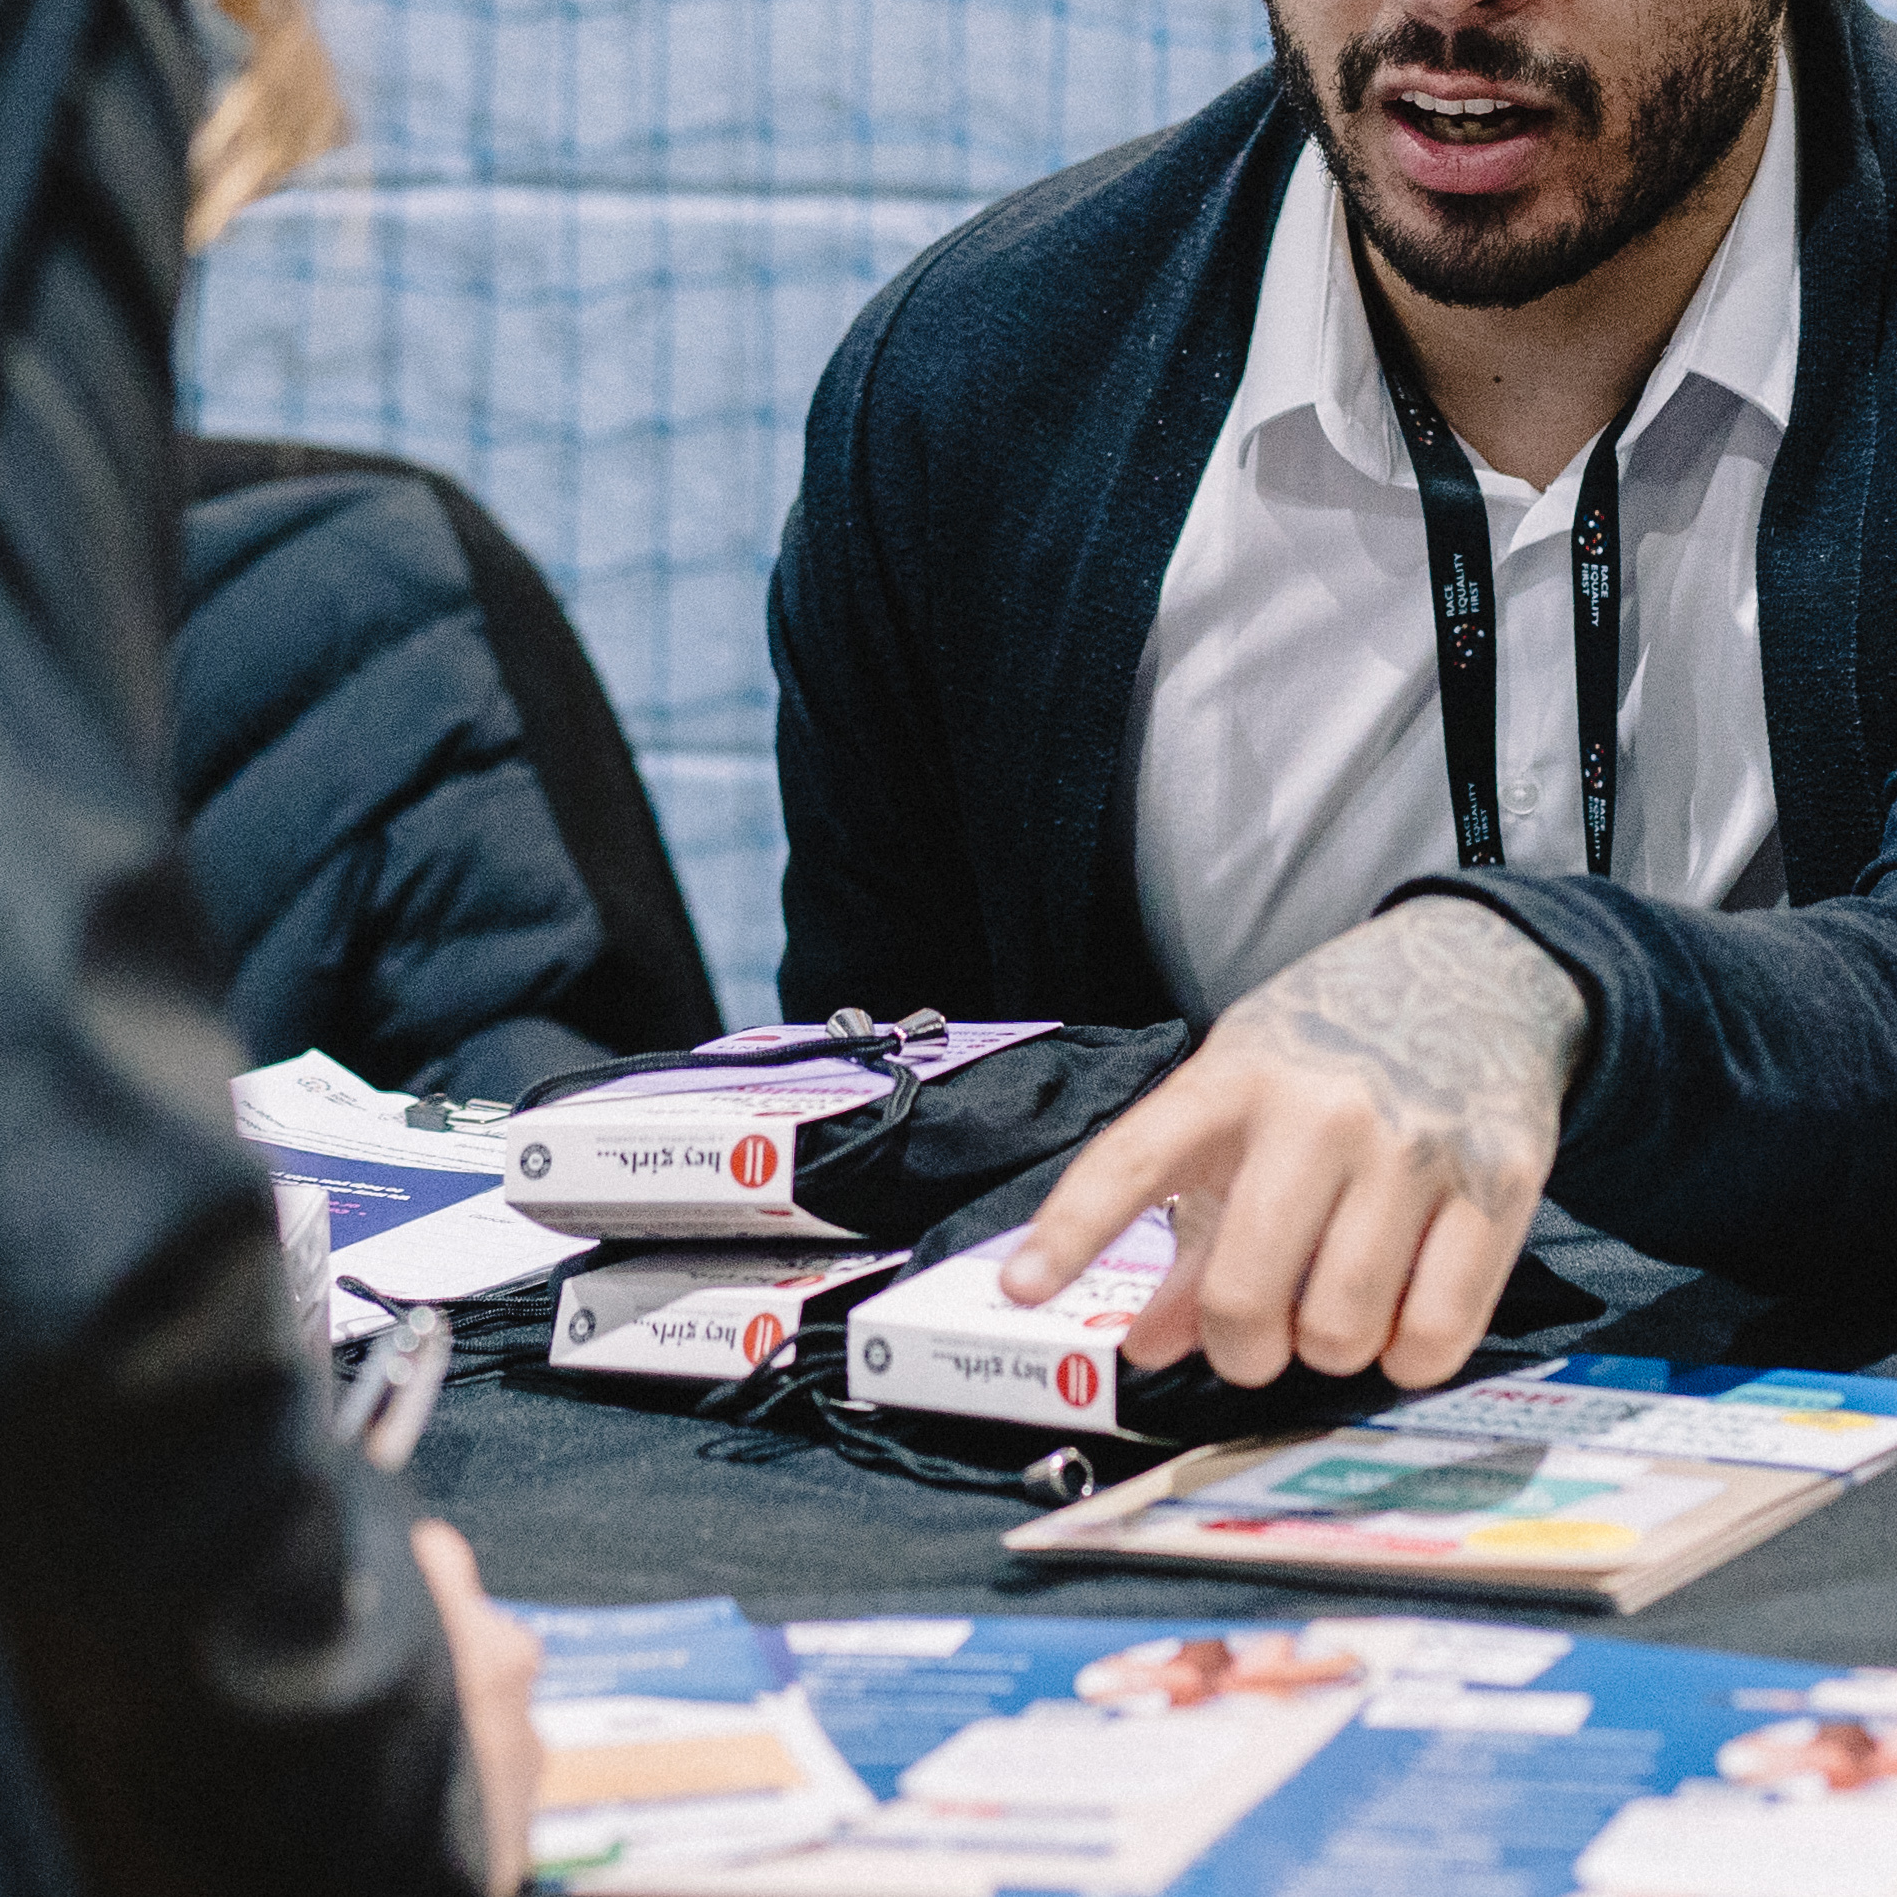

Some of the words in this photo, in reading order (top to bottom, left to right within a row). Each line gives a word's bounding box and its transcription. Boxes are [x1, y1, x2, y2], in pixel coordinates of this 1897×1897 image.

[1453, 553, 1468, 615] EQUALITY
[1581, 563, 1590, 596] FIRST
[1590, 564, 1600, 627] EQUALITY
[1601, 565, 1609, 598] RACE
[1443, 583, 1455, 617] RACE
[1469, 581, 1480, 613] FIRST
[1468, 783, 1481, 843] EQUALITY
[1480, 809, 1489, 840] FIRST
[1593, 797, 1601, 860] EQUALITY
[1463, 815, 1472, 846] RACE
[597, 1148, 674, 1173] girls...
[684, 1146, 721, 1173] hey
[705, 1321, 737, 1350] hey
[1012, 1355, 1048, 1389] hey
